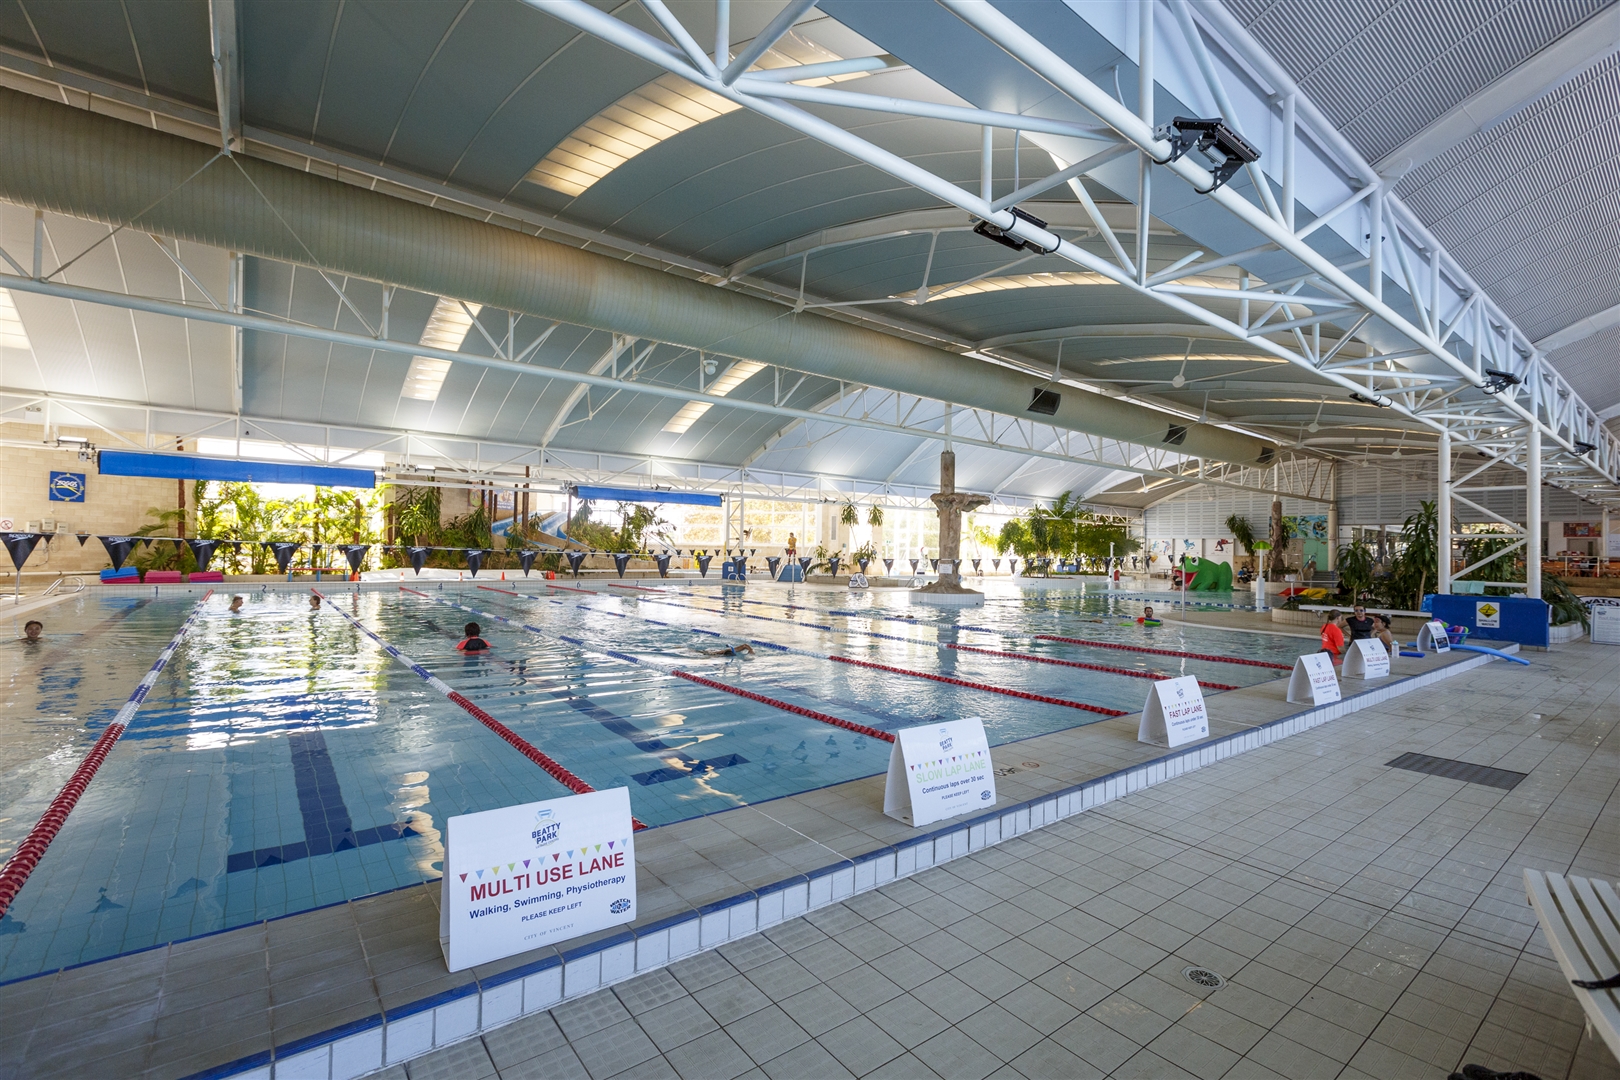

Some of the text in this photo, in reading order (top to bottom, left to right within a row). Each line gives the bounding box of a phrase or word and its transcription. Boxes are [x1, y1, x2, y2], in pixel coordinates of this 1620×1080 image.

[1169, 704, 1202, 718] FAST LAP LANE
[916, 759, 986, 784] SLOW LAP LANE
[922, 784, 949, 794] Continuous
[532, 822, 560, 838] BEATTY
[537, 831, 556, 844] PARK
[471, 852, 624, 901] MULTI USE LANE
[469, 875, 626, 919] Walking, Swimming, Physiotherapy
[521, 901, 582, 922] PLEASE KEEP LEFT
[550, 923, 574, 933] VINCENT
